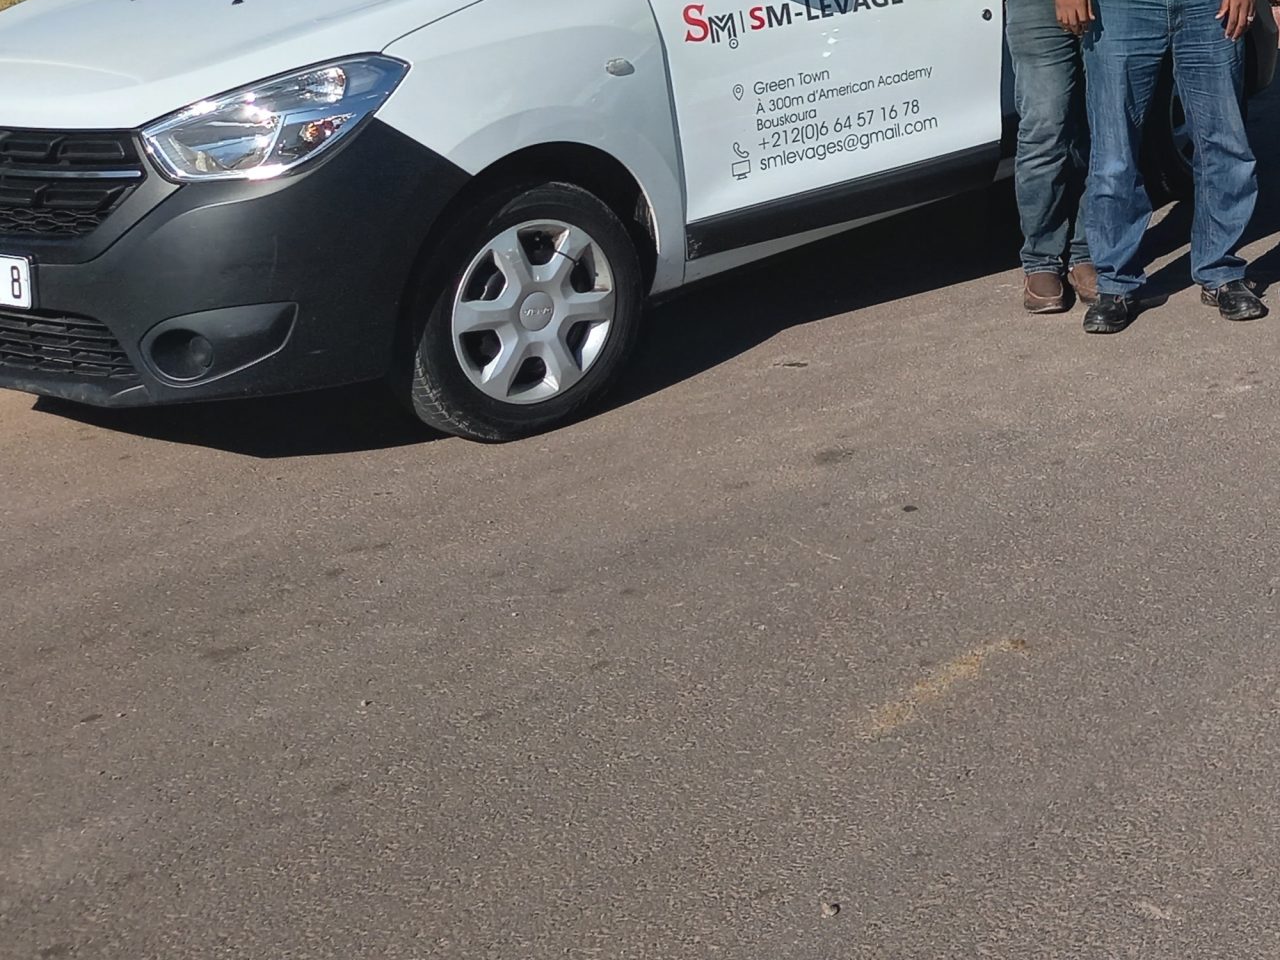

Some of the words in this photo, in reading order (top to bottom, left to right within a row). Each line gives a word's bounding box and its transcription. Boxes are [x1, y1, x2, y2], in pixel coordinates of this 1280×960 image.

[752, 76, 795, 97] Green
[798, 67, 831, 87] Town
[756, 98, 766, 115] À
[768, 93, 805, 114] 300m
[807, 78, 876, 104] d'American
[877, 65, 934, 88] Academy
[756, 107, 817, 132] Bouskoura
[758, 122, 830, 151] +212(0)6
[833, 116, 853, 134] 64
[856, 110, 876, 130] 57
[880, 105, 899, 124] 16
[902, 99, 921, 118] 78
[759, 115, 939, 171] smlevages@gmail.com
[10, 265, 22, 299] 8
